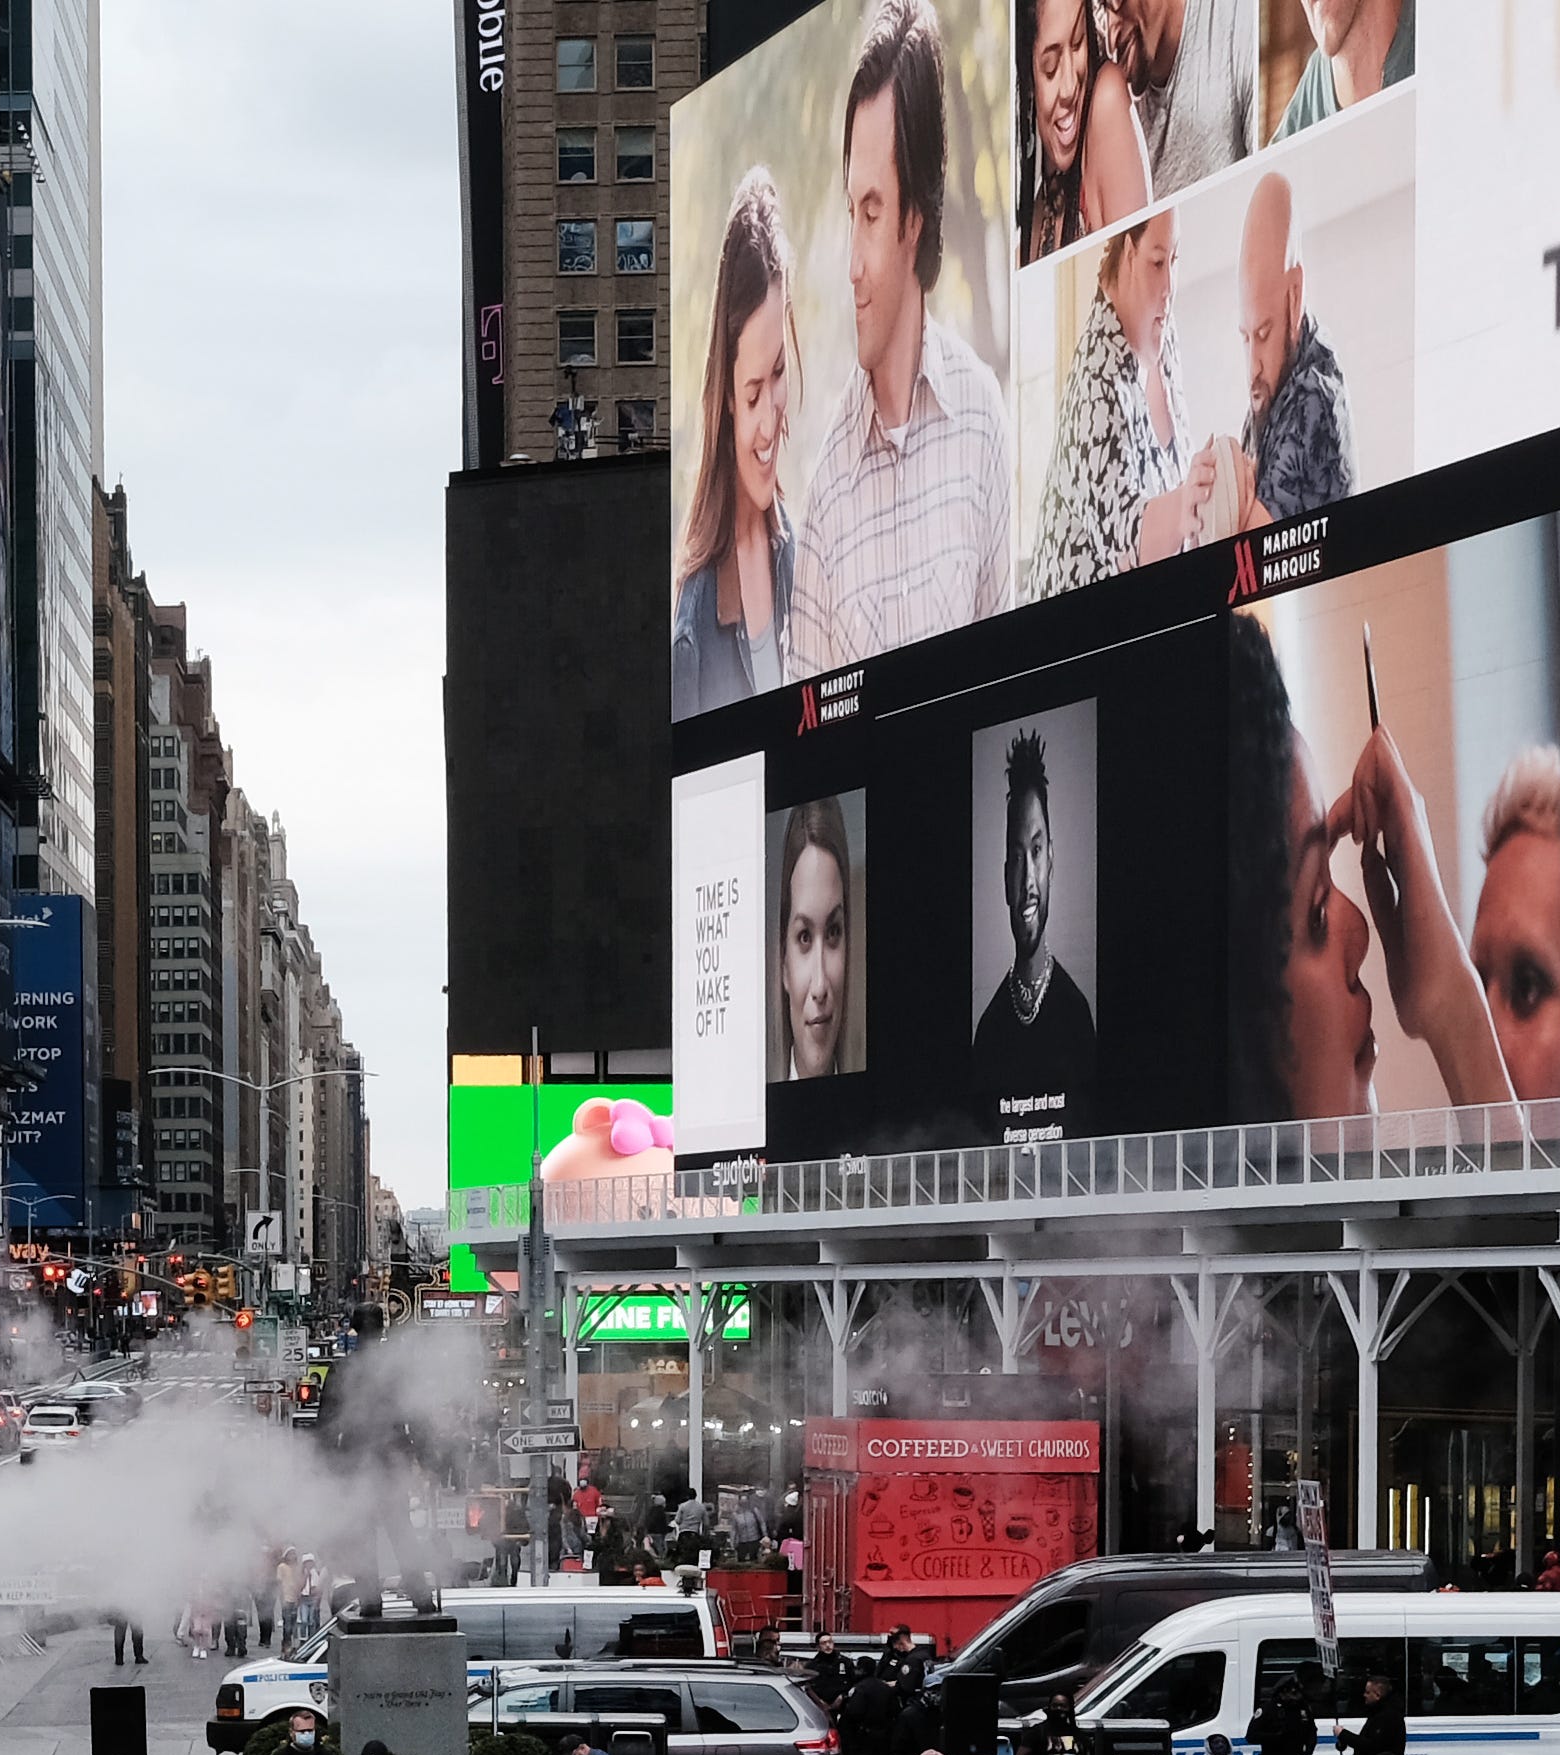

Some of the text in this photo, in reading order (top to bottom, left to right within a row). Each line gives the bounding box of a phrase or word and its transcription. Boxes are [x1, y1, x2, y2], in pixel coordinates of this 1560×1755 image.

[1261, 516, 1330, 557] MARRIOTT
[1261, 548, 1322, 588] MARQUIS
[694, 878, 740, 912] TIME IS
[694, 913, 730, 944] WHAT
[695, 946, 721, 975] YOU
[695, 976, 731, 1006] MAKE
[695, 1006, 726, 1039] OF IT
[282, 1347, 305, 1364] 25
[511, 1431, 570, 1447] ONE WAY
[868, 1439, 969, 1458] COFFEED
[981, 1439, 1023, 1458] SWEET
[1028, 1439, 1090, 1459] CHURROS
[922, 1556, 1031, 1578] COFFEE & TEA
